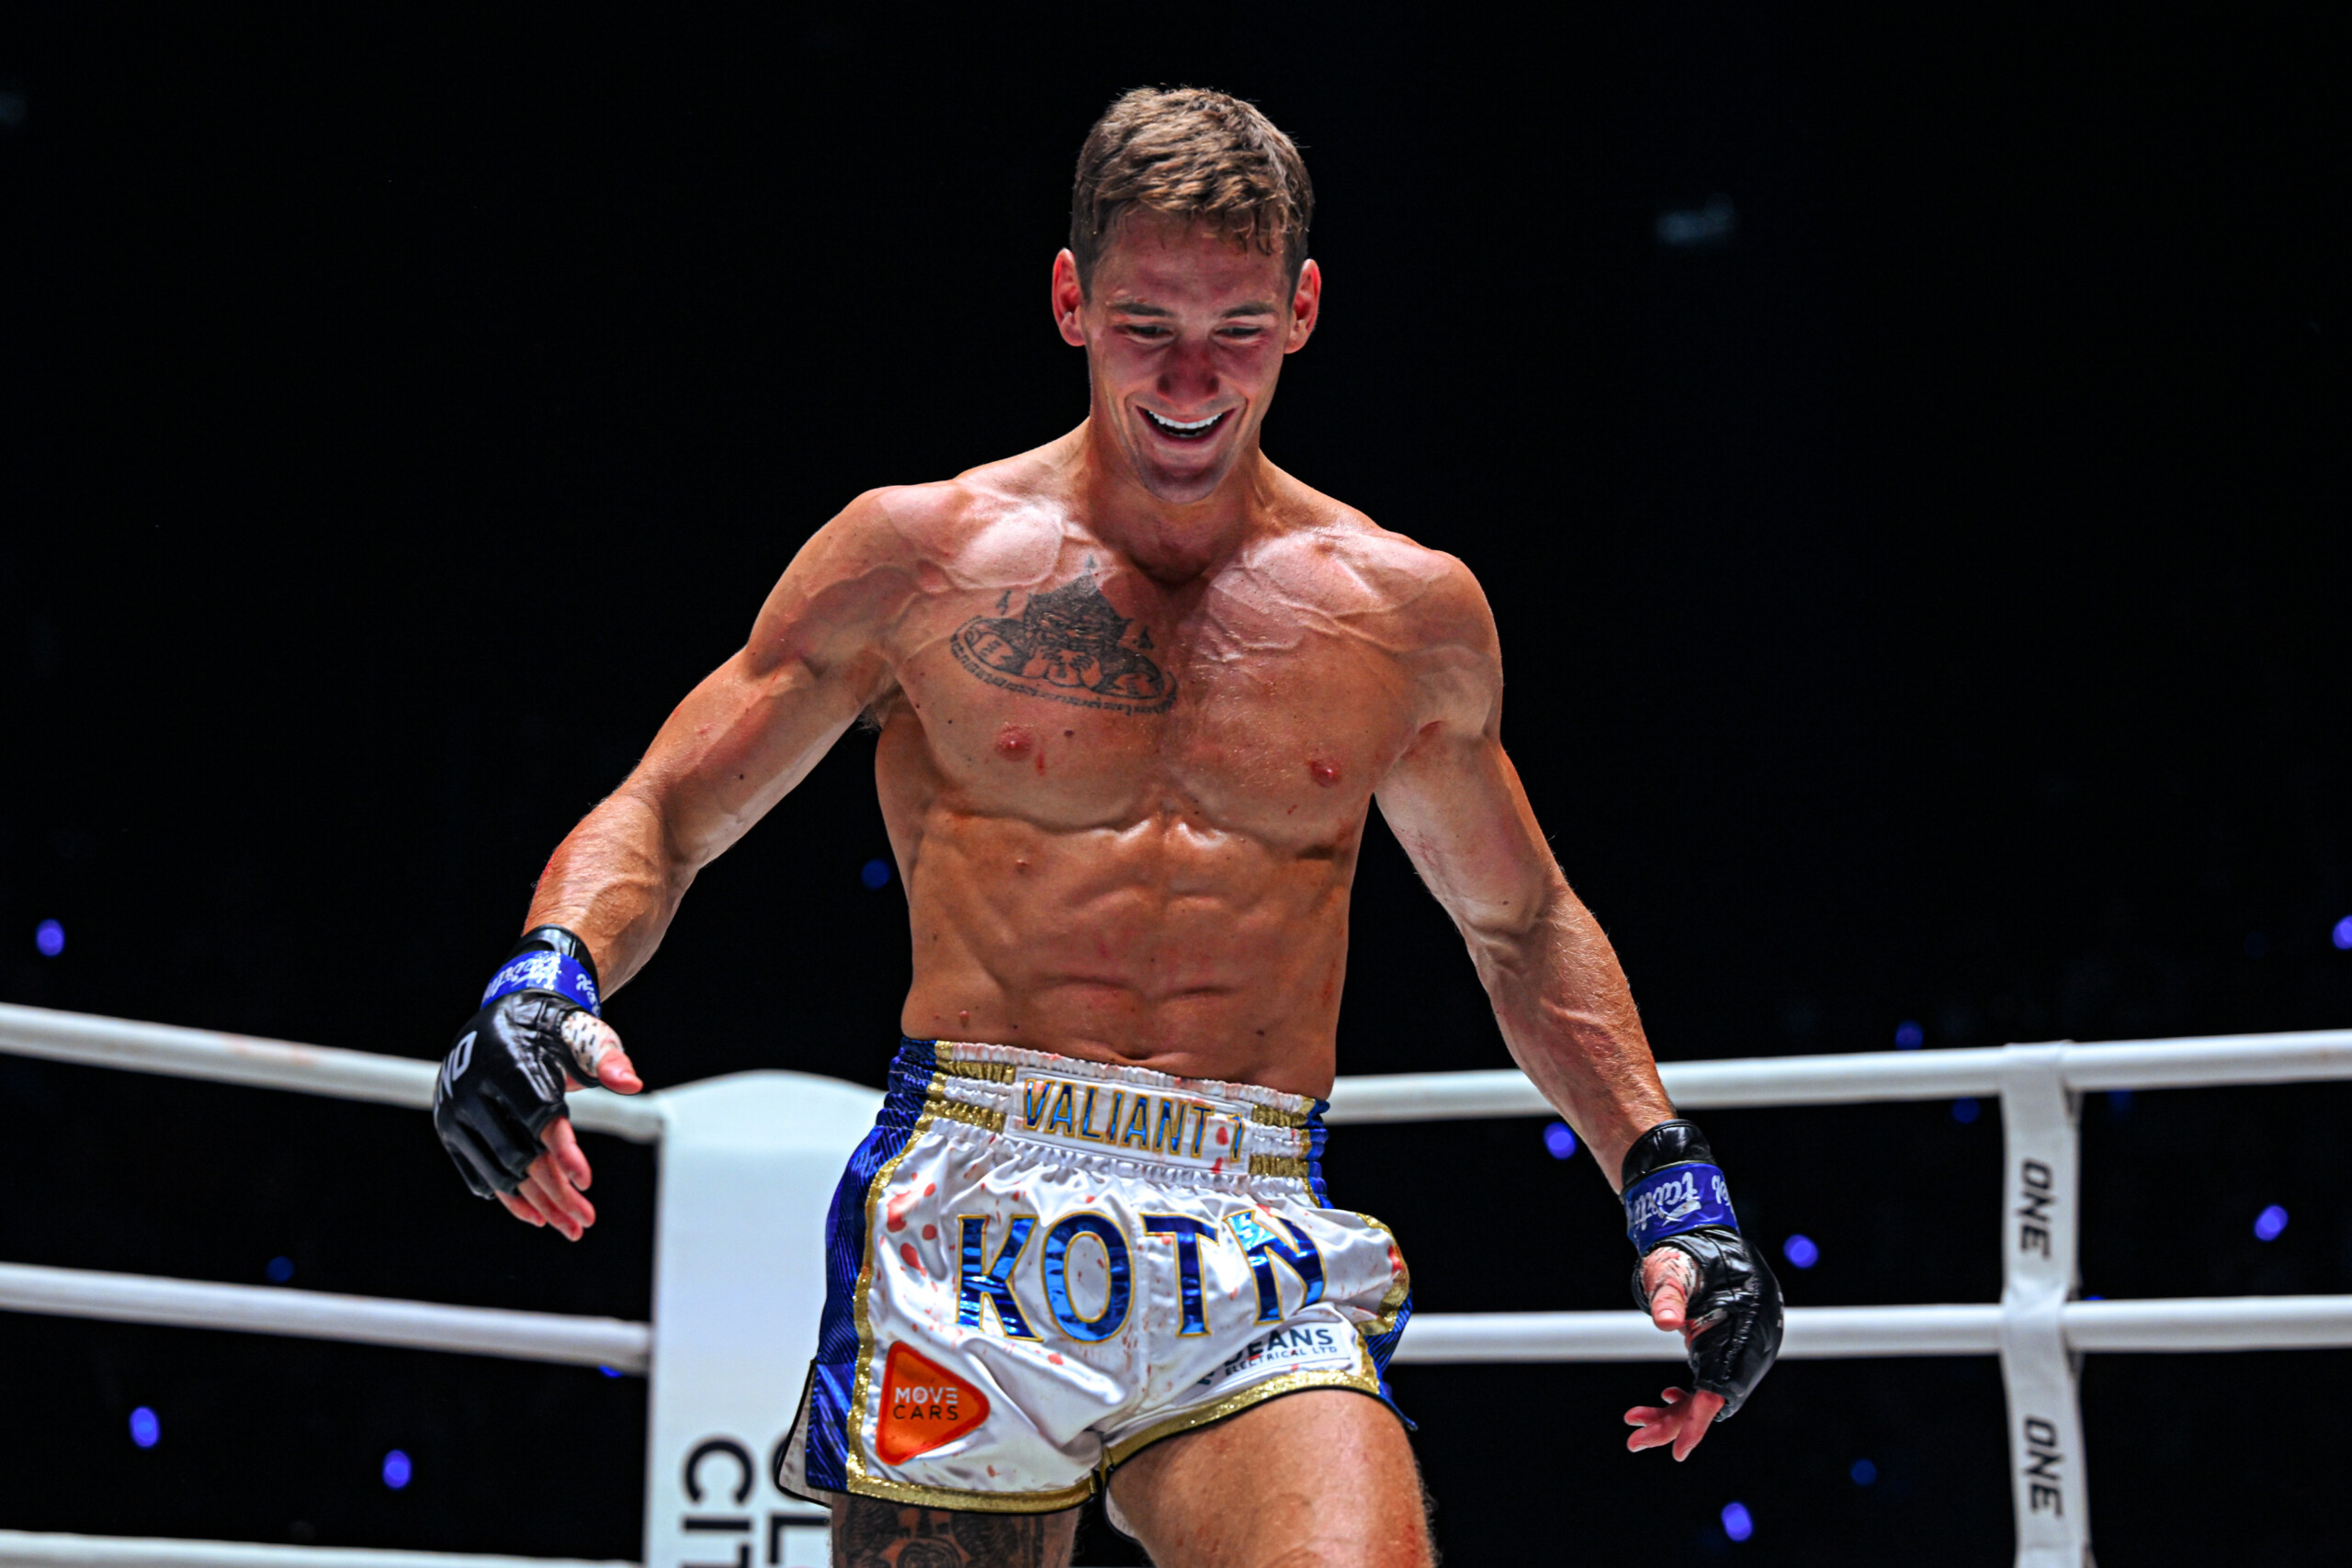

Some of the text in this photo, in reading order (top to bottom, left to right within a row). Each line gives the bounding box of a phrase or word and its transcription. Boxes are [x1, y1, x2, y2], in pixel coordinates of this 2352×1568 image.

[1023, 1077, 1246, 1163] VALIANT 1
[2017, 1159, 2054, 1258] ONE
[955, 1210, 1327, 1344] KOTN
[895, 1386, 958, 1404] MOVE
[1225, 1346, 1338, 1376] ELECTRICAL LTD
[893, 1404, 958, 1420] CARS
[2023, 1416, 2064, 1517] ONE
